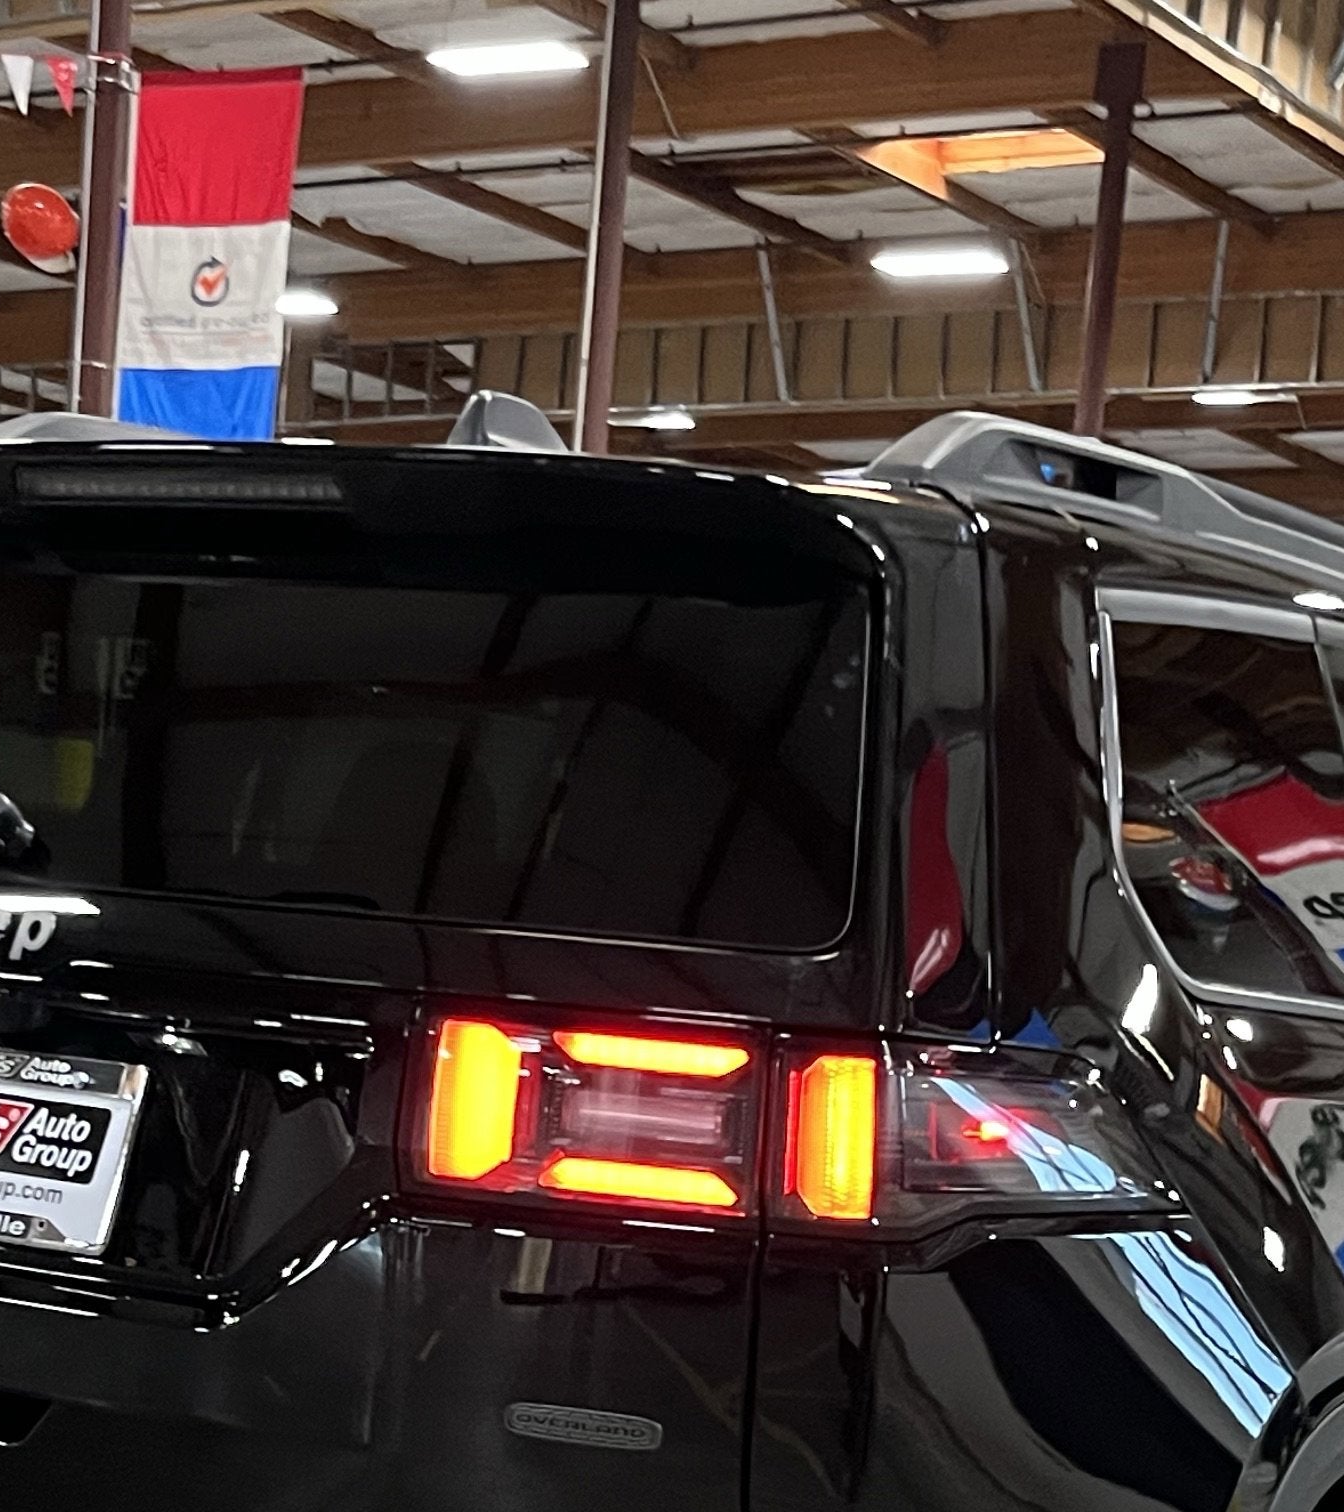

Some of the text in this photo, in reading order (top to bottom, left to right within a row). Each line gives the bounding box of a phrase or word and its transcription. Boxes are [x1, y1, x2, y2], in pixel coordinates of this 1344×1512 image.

[20, 1067, 76, 1088] Group
[28, 1056, 72, 1074] Auto
[22, 1107, 92, 1142] Auto
[10, 1134, 93, 1178] Group
[515, 1413, 646, 1438] OVERLAND
